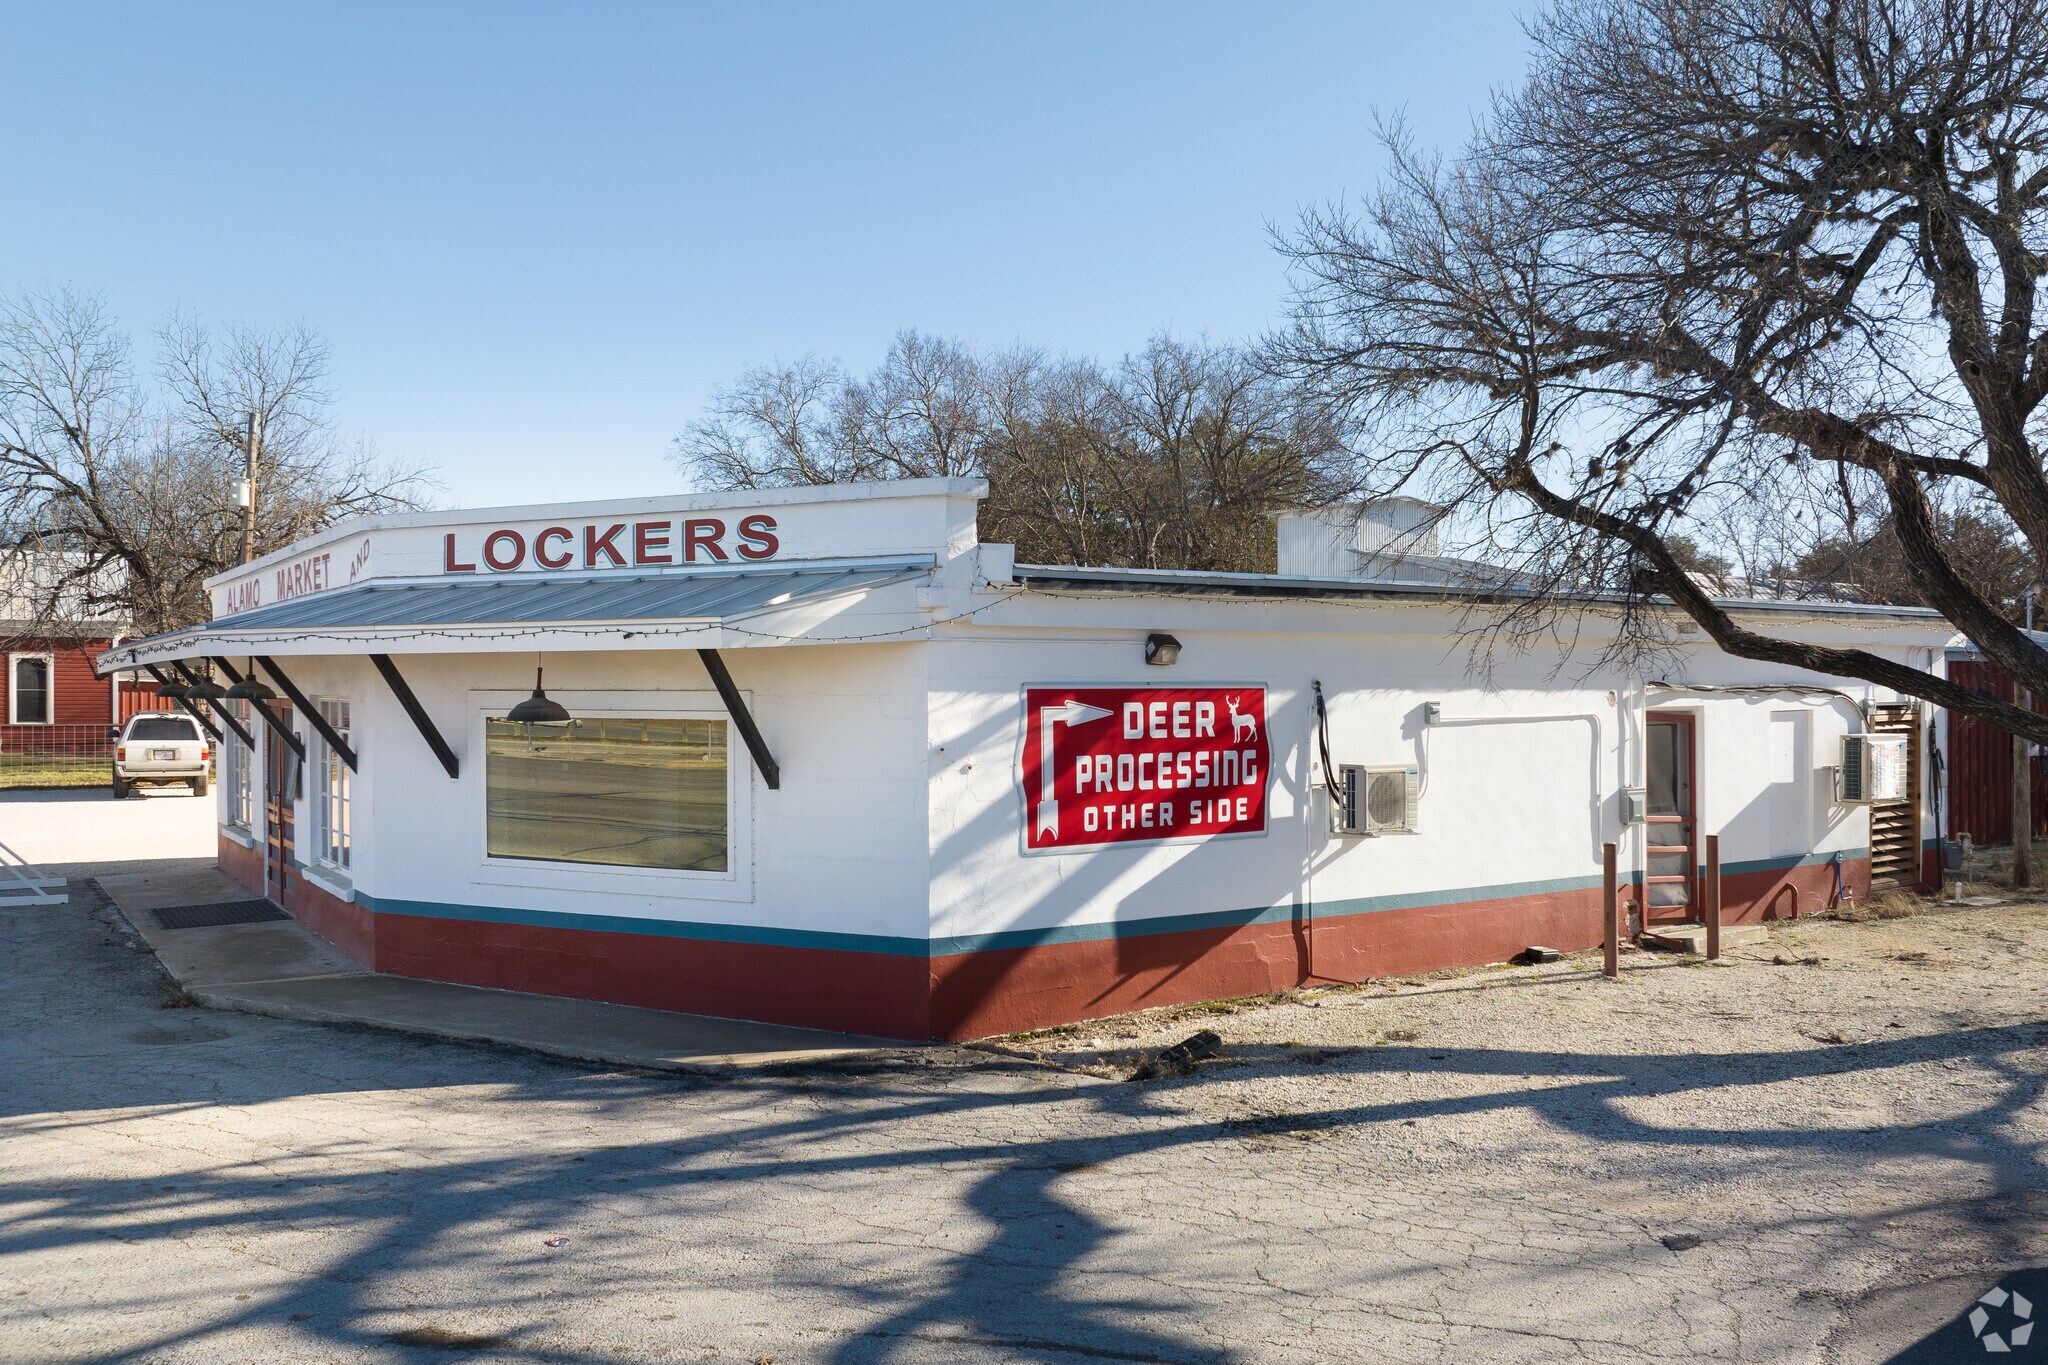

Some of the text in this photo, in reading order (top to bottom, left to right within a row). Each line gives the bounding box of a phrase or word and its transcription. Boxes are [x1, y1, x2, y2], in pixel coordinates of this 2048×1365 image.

[227, 514, 779, 614] ALAMO MARKET AND LOCKERS
[1123, 701, 1215, 739] DEER
[1076, 749, 1257, 794] PROCESSING
[1083, 797, 1248, 832] OTHER SIDE
